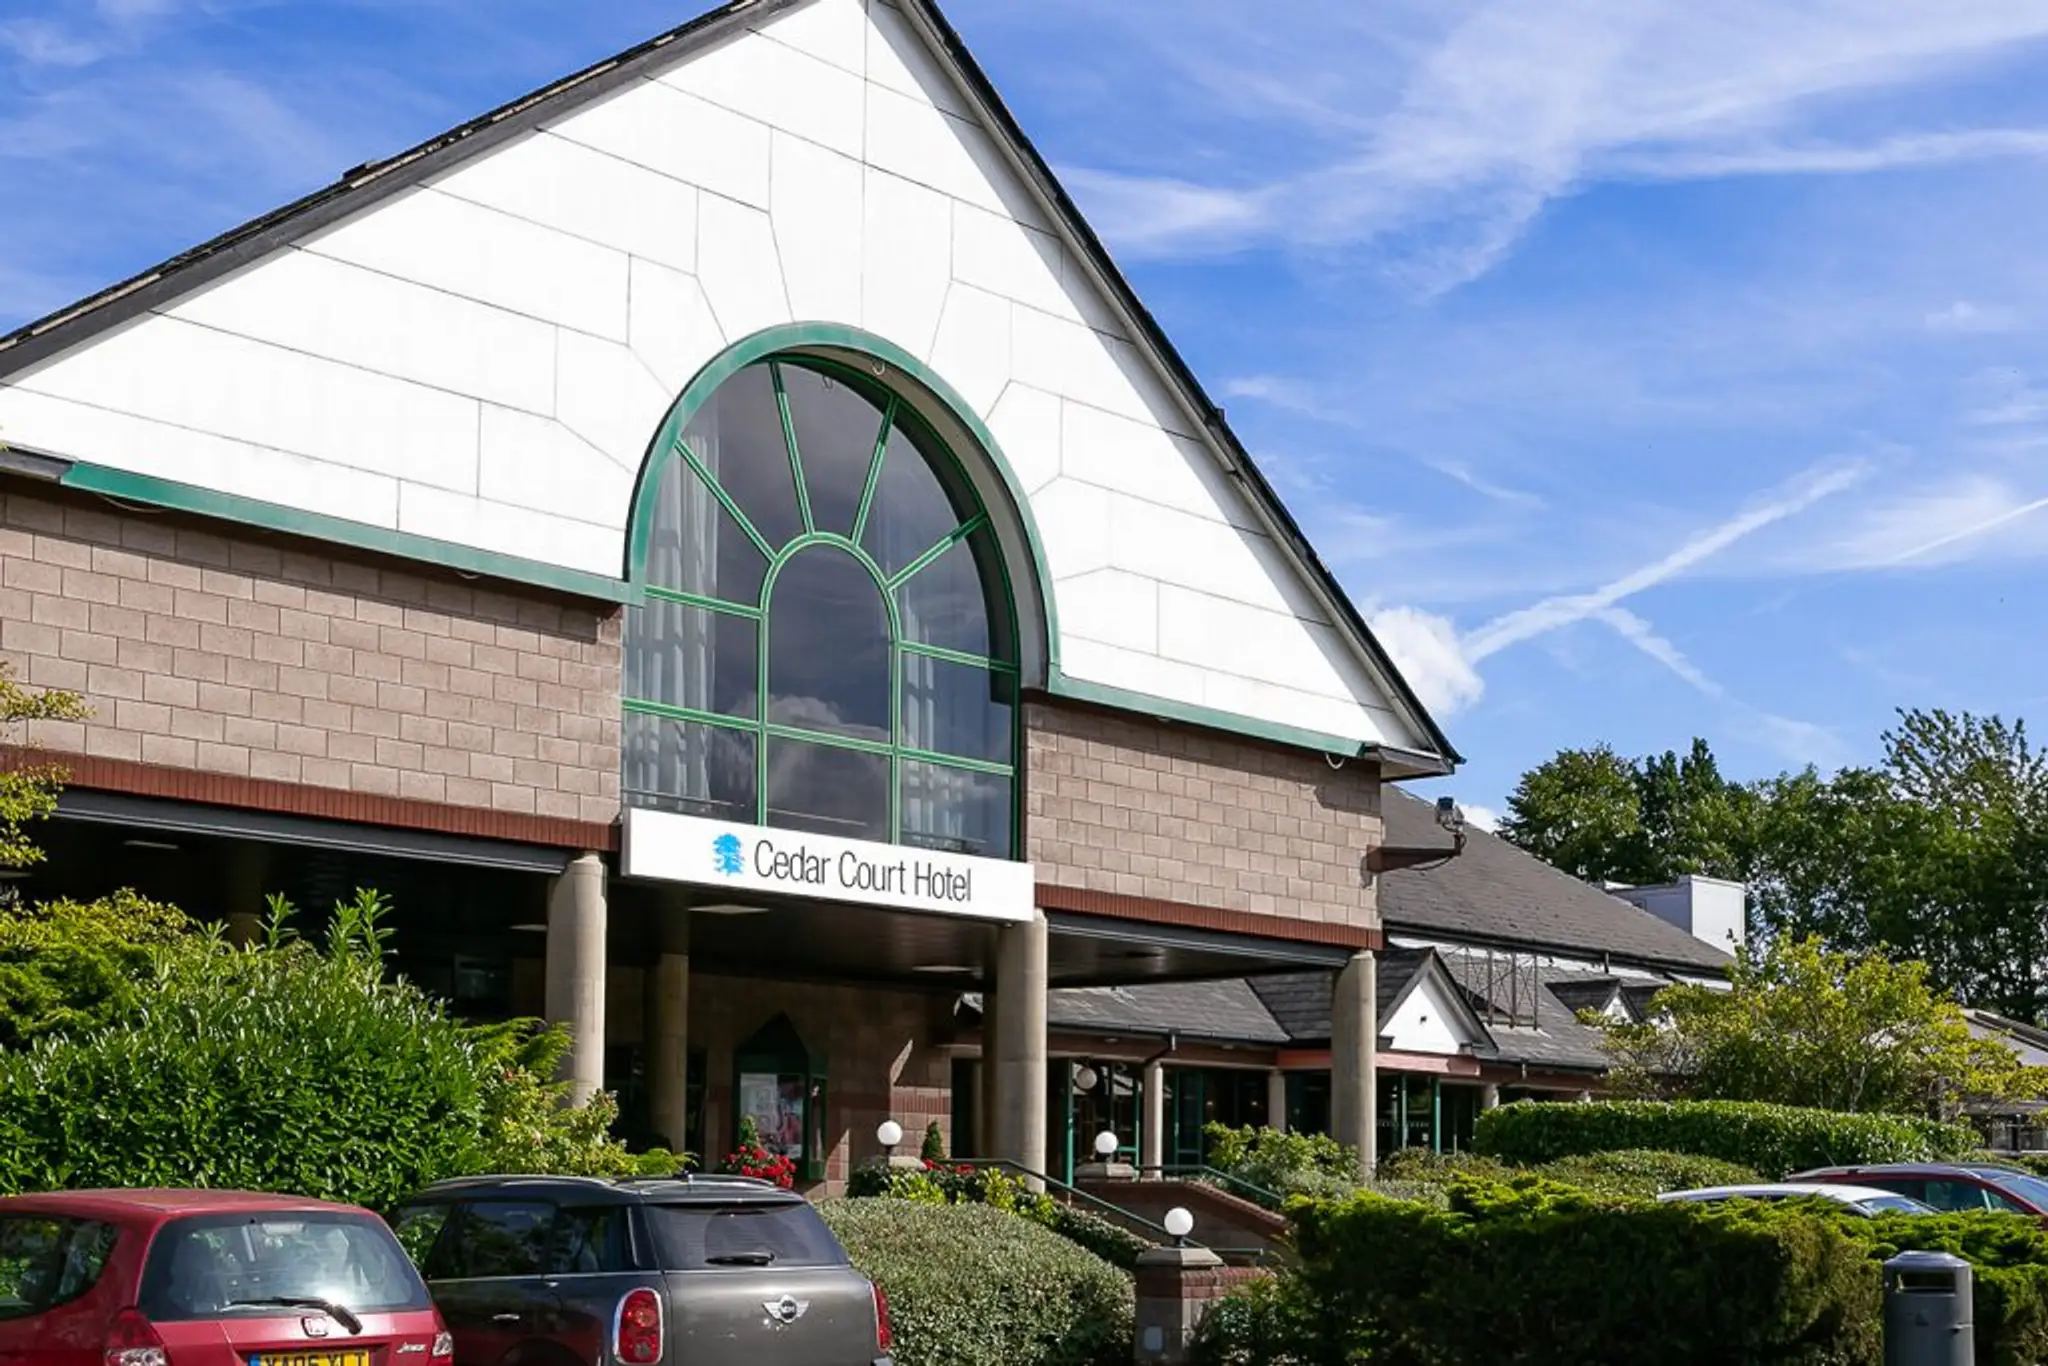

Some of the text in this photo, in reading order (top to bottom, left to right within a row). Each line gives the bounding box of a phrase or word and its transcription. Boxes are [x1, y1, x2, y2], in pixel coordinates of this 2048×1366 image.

[754, 839, 972, 902] Cedar Court Hotel
